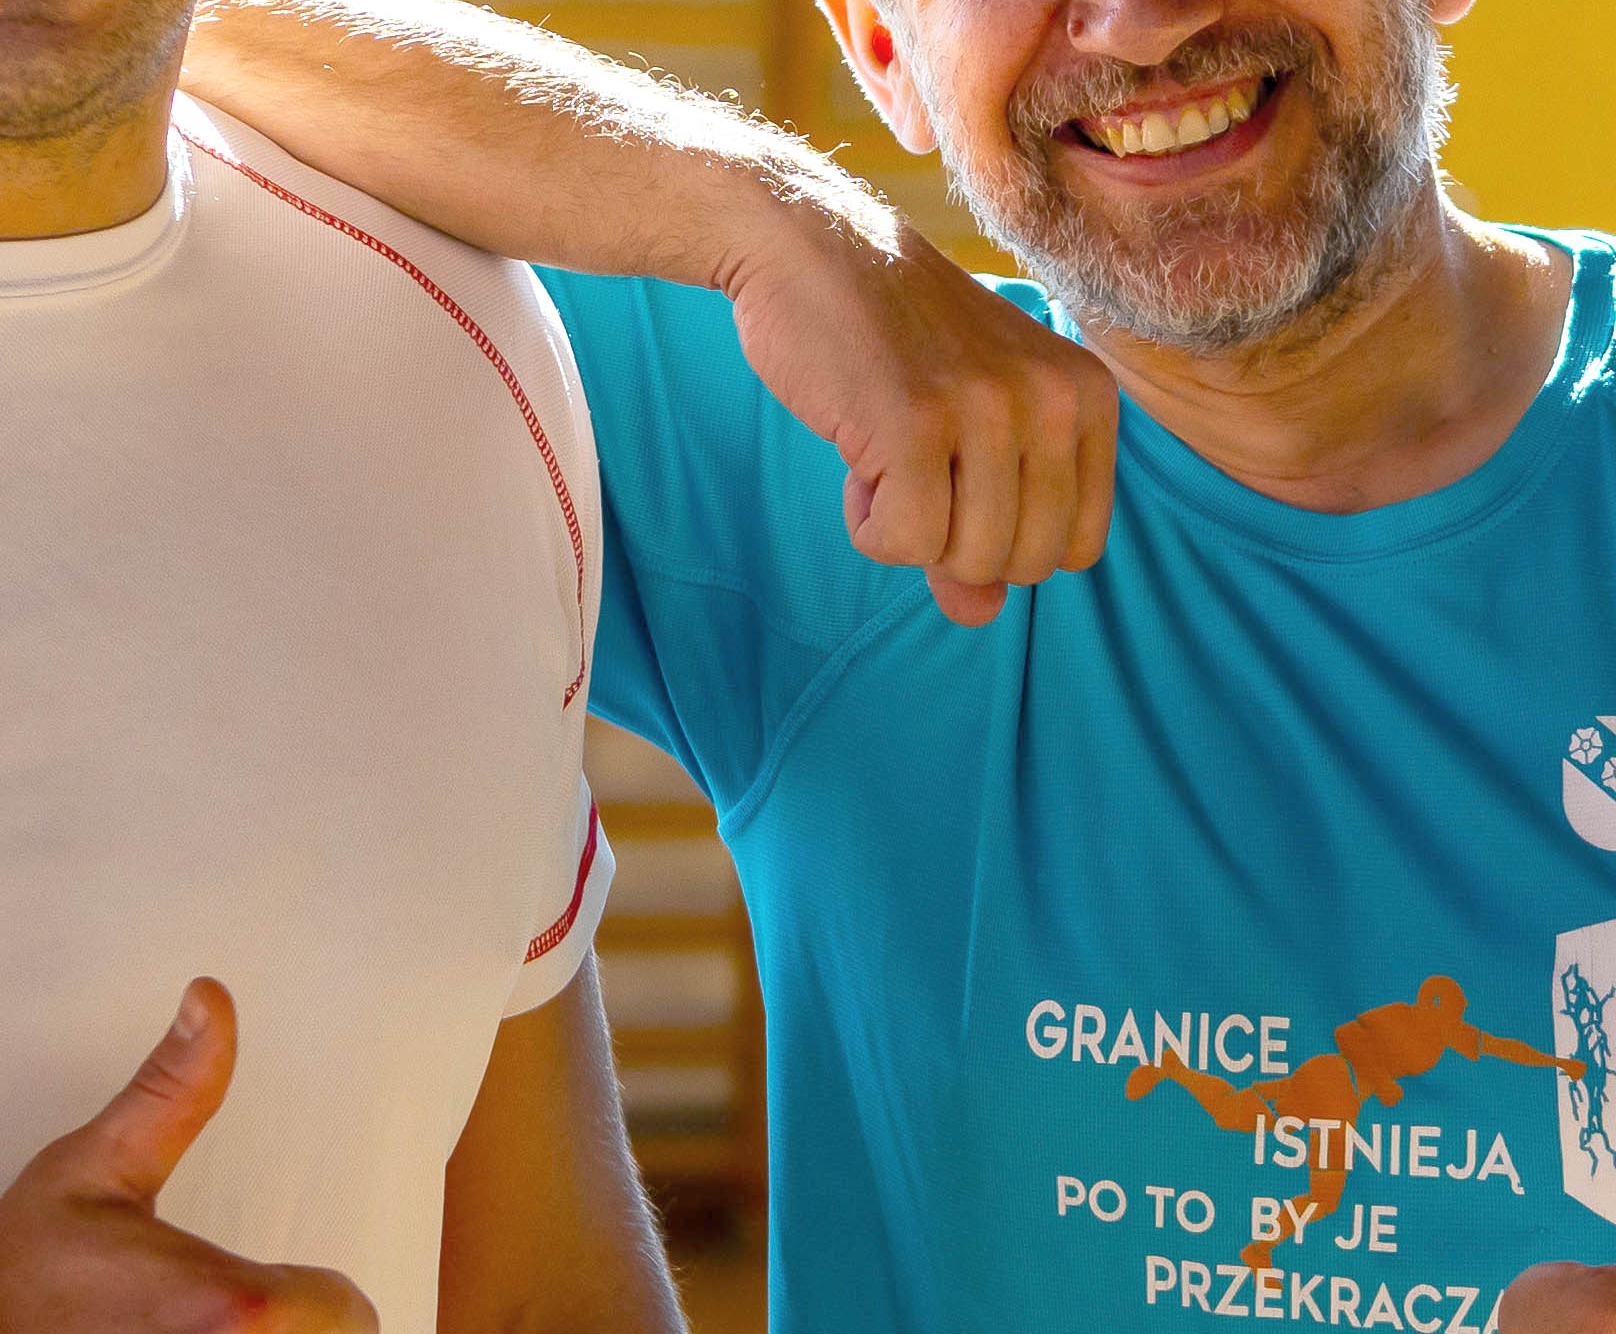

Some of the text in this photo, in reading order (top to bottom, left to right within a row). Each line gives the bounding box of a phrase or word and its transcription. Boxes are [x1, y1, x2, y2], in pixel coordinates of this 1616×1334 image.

[1025, 999, 1291, 1075] GRANICE
[1254, 1114, 1525, 1196] ISTNIEJĄ
[1056, 1175, 1398, 1253] PO TO BY JE
